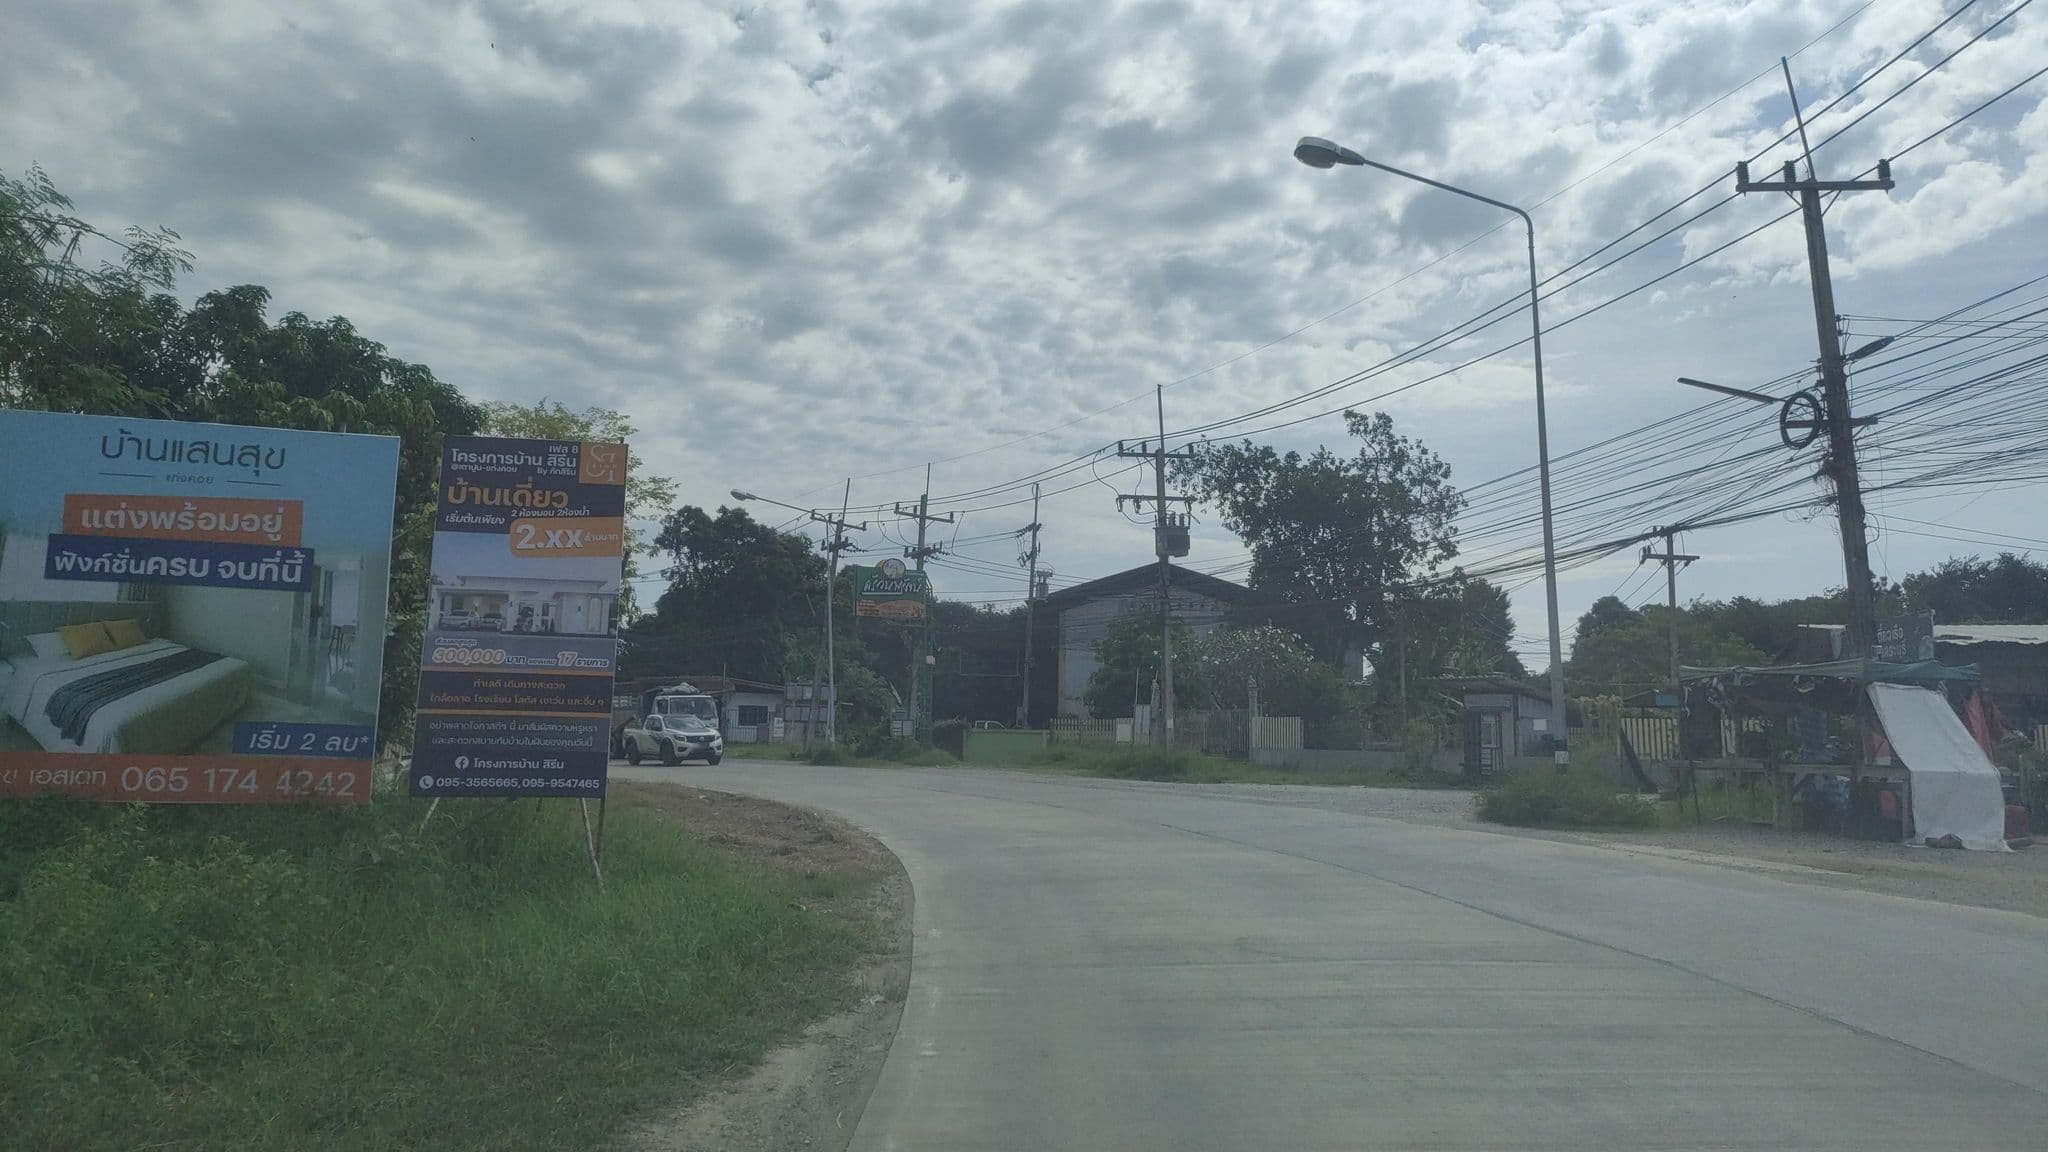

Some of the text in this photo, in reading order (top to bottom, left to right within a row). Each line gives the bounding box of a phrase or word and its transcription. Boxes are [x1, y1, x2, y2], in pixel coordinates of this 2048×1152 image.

[100, 429, 287, 478] บ้านแสนสุข
[451, 448, 542, 466] โครงการบ้าน
[571, 445, 579, 454] 8
[447, 476, 569, 508] บ้านเดี่ยว
[81, 501, 285, 542] แต่งพร้อมอยู่
[445, 510, 506, 525] เริ่มต้นเพียง
[511, 509, 518, 517] 2
[519, 508, 555, 517] ห้องนอน
[54, 549, 307, 583] ฟังก์ชั่นครบ จบที่นี้
[432, 648, 506, 665] 300,000
[505, 655, 526, 665] บาท
[557, 650, 578, 667] 17
[576, 657, 609, 668] รายการ
[249, 725, 289, 750] เริ่ม
[300, 733, 314, 750] 2
[474, 757, 539, 769] โครงการบ้าน
[28, 769, 107, 786] เอสเตท
[120, 766, 189, 793] 065
[204, 766, 259, 794] 174
[275, 768, 357, 797] 4242
